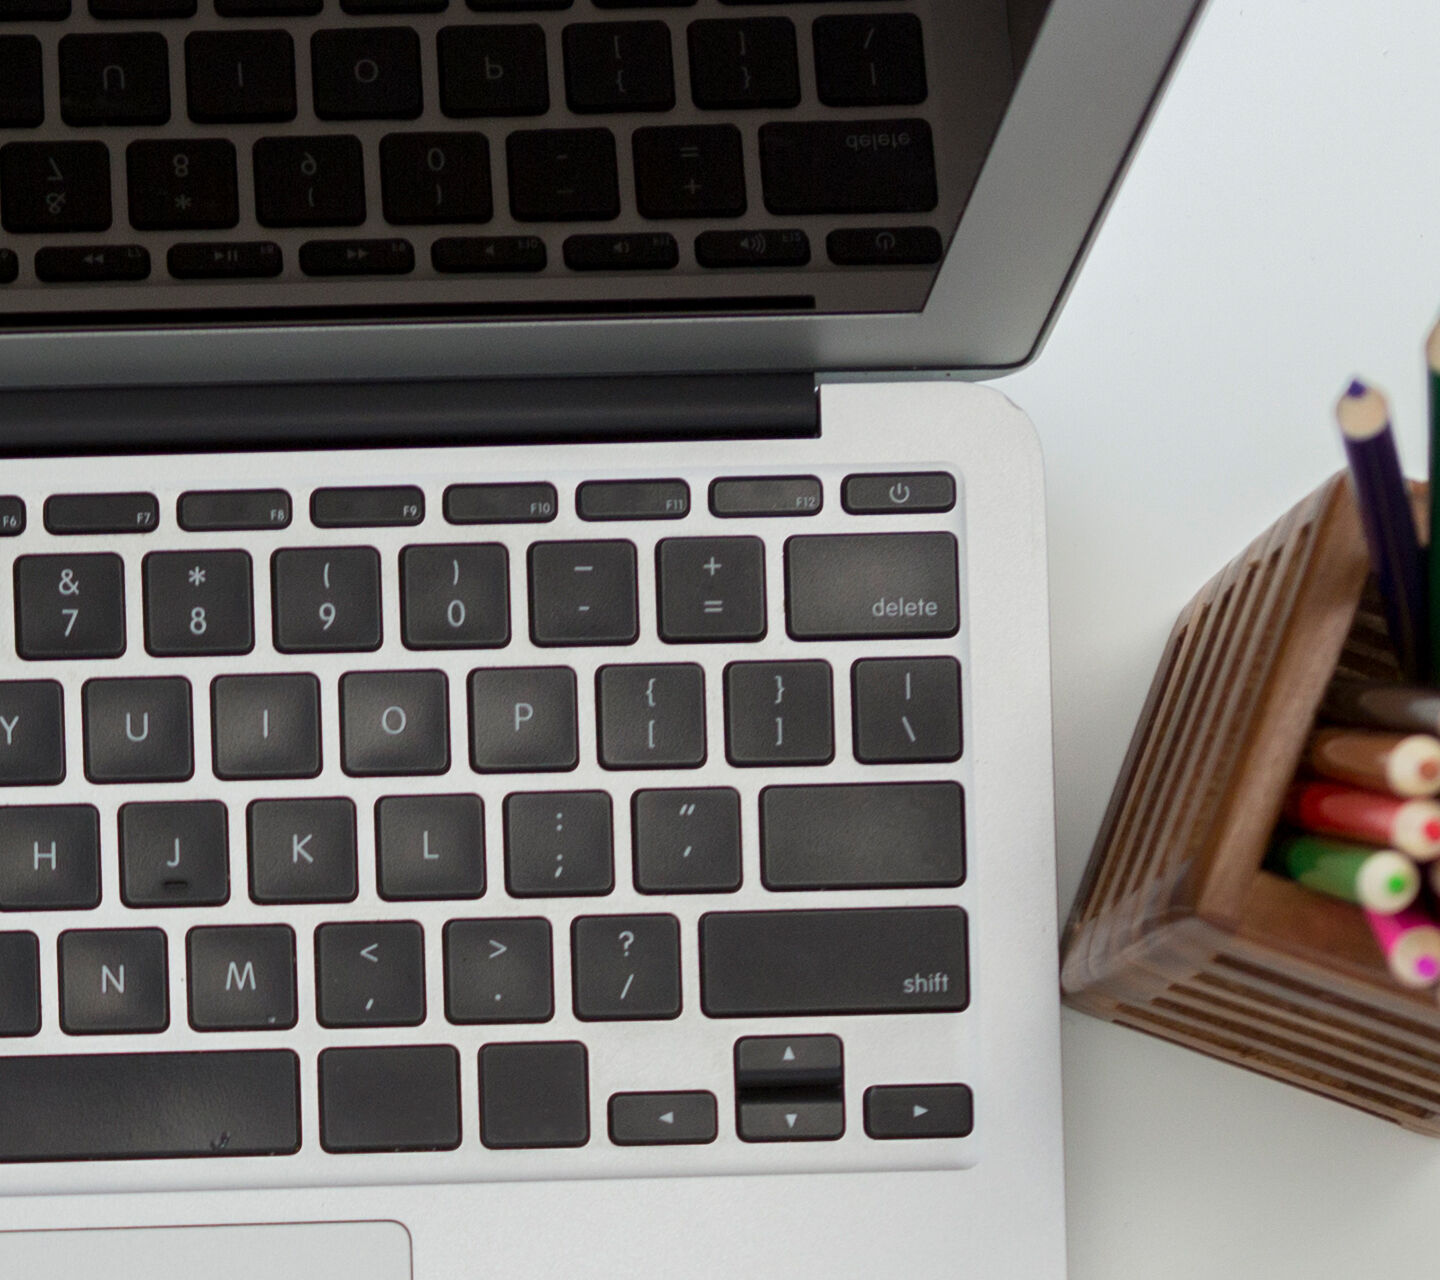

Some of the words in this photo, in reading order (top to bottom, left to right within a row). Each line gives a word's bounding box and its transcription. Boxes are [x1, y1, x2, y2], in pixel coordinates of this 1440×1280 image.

[270, 509, 285, 522] F8
[403, 505, 417, 517] F9
[530, 502, 551, 514] F10
[665, 499, 683, 510] F11
[795, 496, 816, 508] F12
[2, 515, 17, 527] F6
[136, 512, 151, 524] F7
[323, 562, 330, 589] (
[453, 559, 459, 586] )
[703, 556, 722, 576] +
[58, 568, 80, 595] &
[318, 602, 336, 630] 9
[447, 599, 466, 627] 0
[704, 600, 723, 613] =
[872, 597, 938, 617] delete
[62, 609, 79, 637] 7
[189, 606, 207, 635] 8
[645, 678, 656, 707] {
[775, 675, 785, 704] }
[905, 672, 911, 700] |
[0, 715, 19, 745] Y
[125, 712, 149, 742] U
[263, 709, 269, 739] I
[381, 706, 407, 735] O
[514, 702, 534, 731] P
[901, 716, 916, 742] \
[648, 719, 656, 749] [
[775, 717, 783, 746] ]
[556, 812, 563, 831] :
[679, 804, 695, 816] "
[33, 841, 57, 871] H
[166, 837, 180, 867] J
[292, 834, 314, 863] K
[423, 830, 439, 860] L
[554, 854, 563, 878] ;
[360, 943, 378, 962] <
[489, 939, 507, 959] >
[618, 930, 634, 957] ?
[101, 965, 125, 994] N
[225, 961, 256, 991] M
[620, 973, 634, 1000] /
[903, 972, 949, 993] shift
